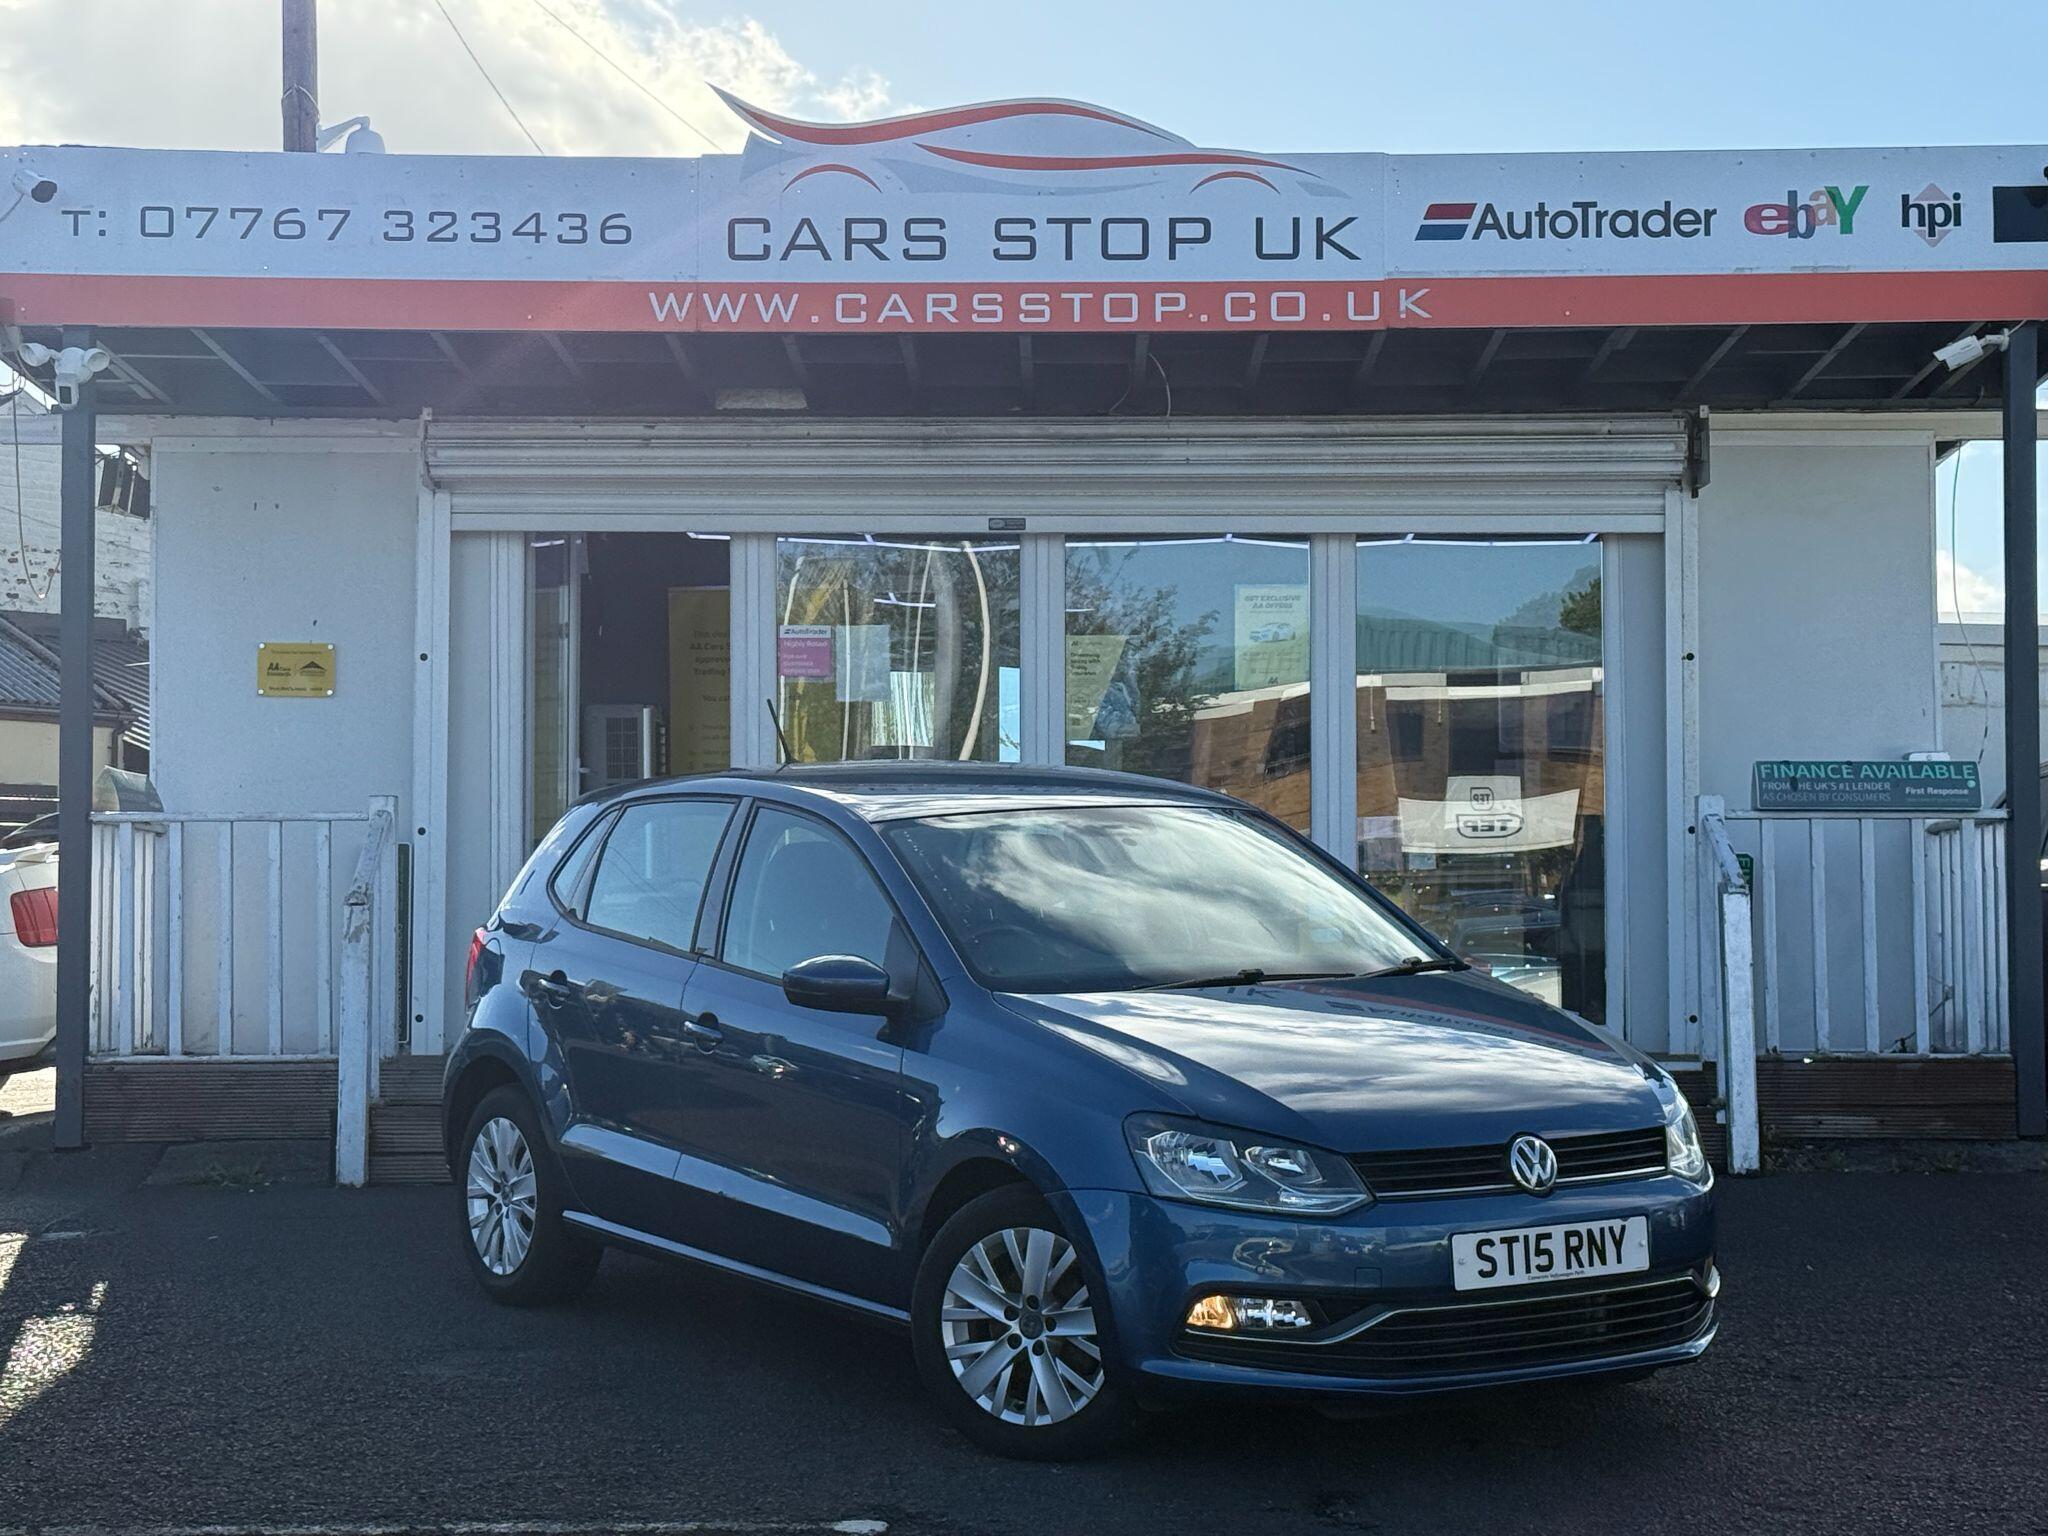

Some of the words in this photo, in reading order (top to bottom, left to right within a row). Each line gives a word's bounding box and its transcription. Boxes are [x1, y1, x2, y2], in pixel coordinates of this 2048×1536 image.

[61, 209, 107, 237] T:
[140, 206, 352, 242] 07767
[382, 209, 634, 246] 323436
[1472, 200, 1717, 241] AutoTrader
[1901, 191, 1962, 239] hpi
[727, 216, 947, 261] CARS
[993, 216, 1212, 261] STOP
[1256, 216, 1361, 261] UK
[649, 287, 1431, 324] WWW.CARSSTOP.CO.UK
[1760, 763, 1854, 779] FINANCE
[1860, 763, 1976, 780] AVAILABLE
[1762, 781, 1791, 791] FROM
[1852, 781, 1891, 791] LENDER
[1905, 786, 1925, 796] First
[1926, 786, 1969, 797] Response
[1475, 1232, 1554, 1279] ST15
[1564, 1224, 1627, 1270] RNY
